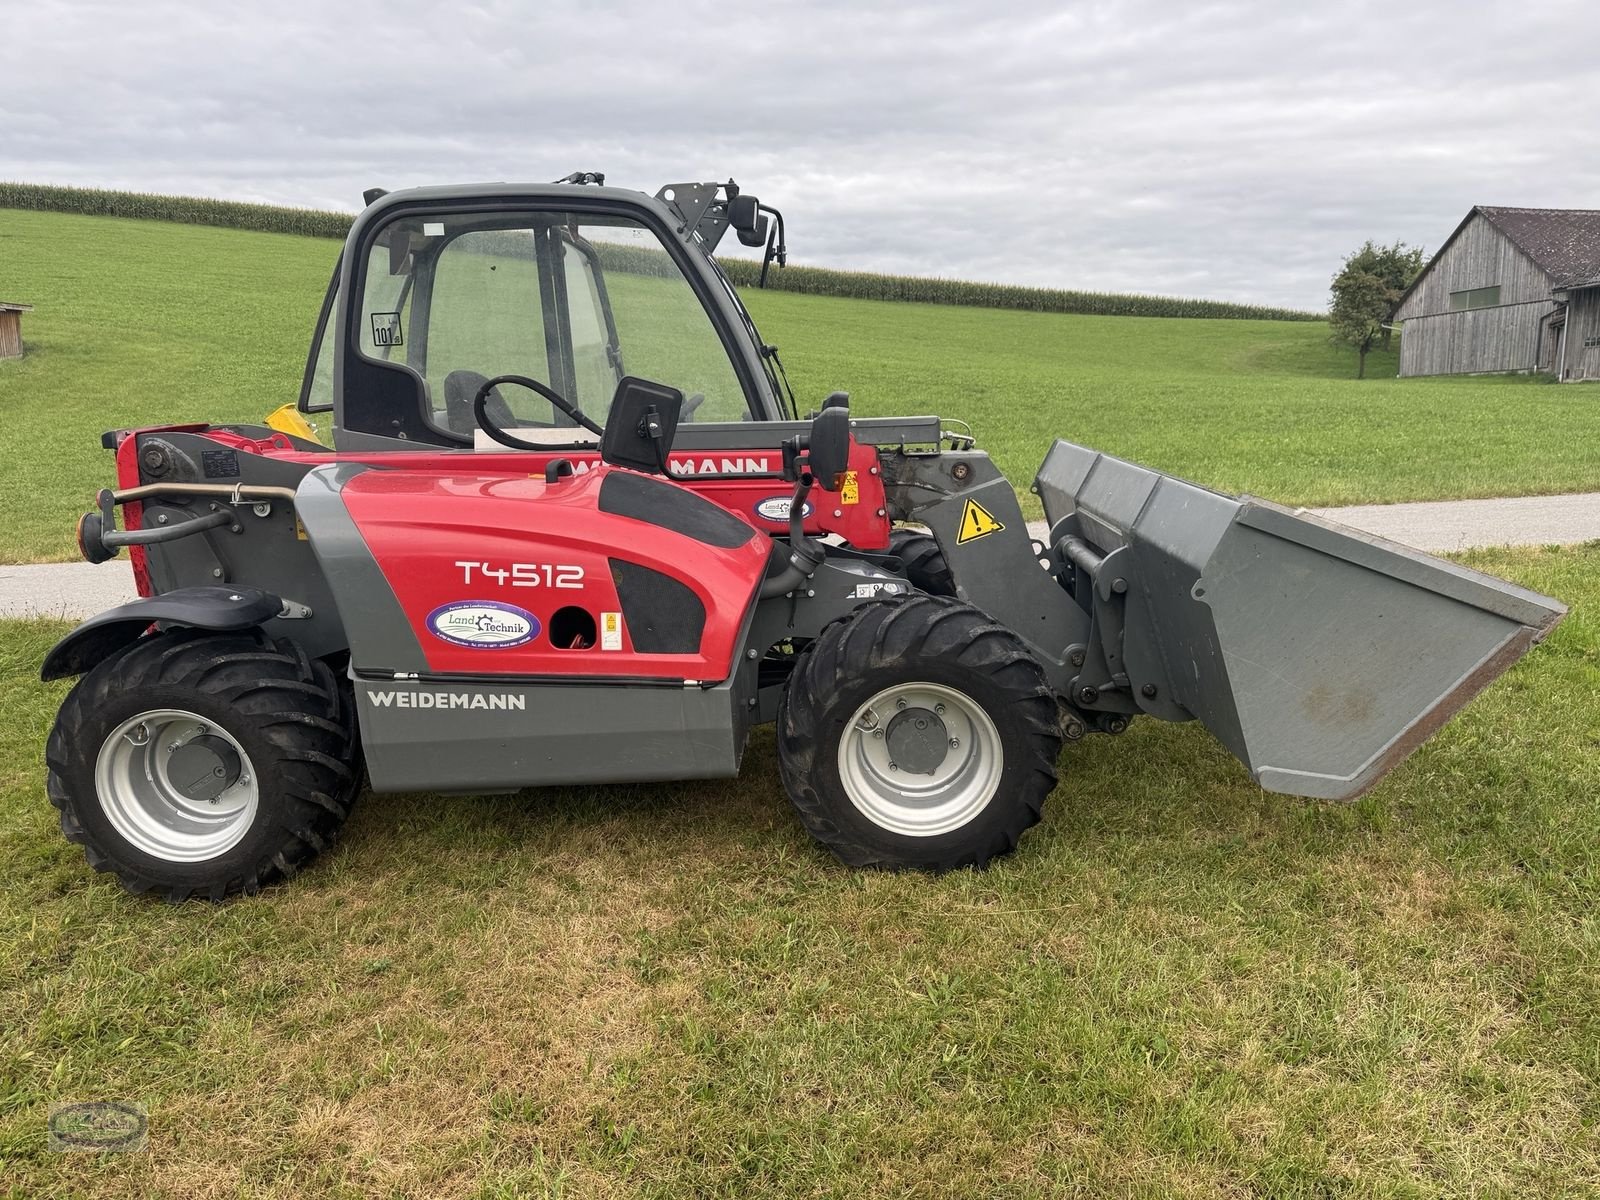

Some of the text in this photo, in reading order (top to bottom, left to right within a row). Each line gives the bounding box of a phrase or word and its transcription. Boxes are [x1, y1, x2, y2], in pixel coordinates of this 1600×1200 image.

[375, 327, 393, 344] 101
[455, 561, 585, 589] T4512
[448, 614, 475, 625] Land
[484, 622, 524, 633] Technik
[367, 691, 526, 710] WEIDEMANN
